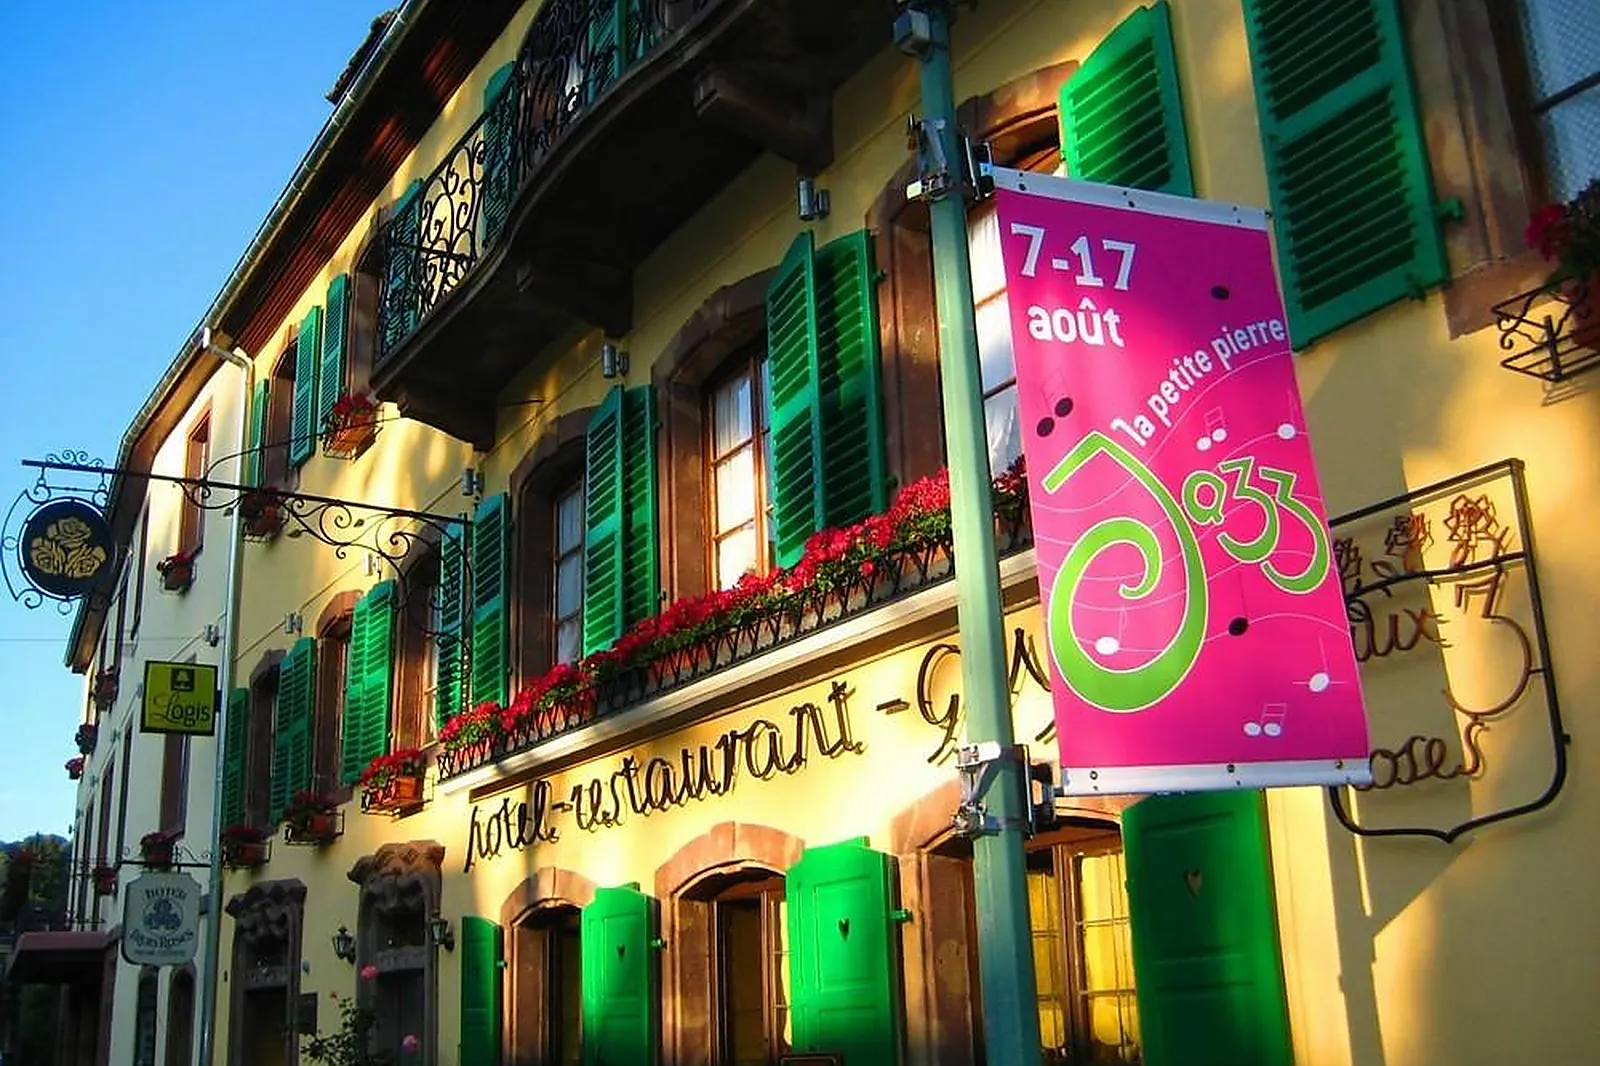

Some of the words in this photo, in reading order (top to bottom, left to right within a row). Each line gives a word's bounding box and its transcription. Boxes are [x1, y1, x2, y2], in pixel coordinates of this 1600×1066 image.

[1010, 223, 1137, 291] 7-17
[1027, 297, 1125, 348] août
[1111, 415, 1156, 448] la
[1147, 349, 1213, 427] petite
[1211, 316, 1286, 371] pierre
[1041, 430, 1332, 714] Jazz
[150, 689, 211, 727] Logis
[1354, 721, 1486, 791] oses
